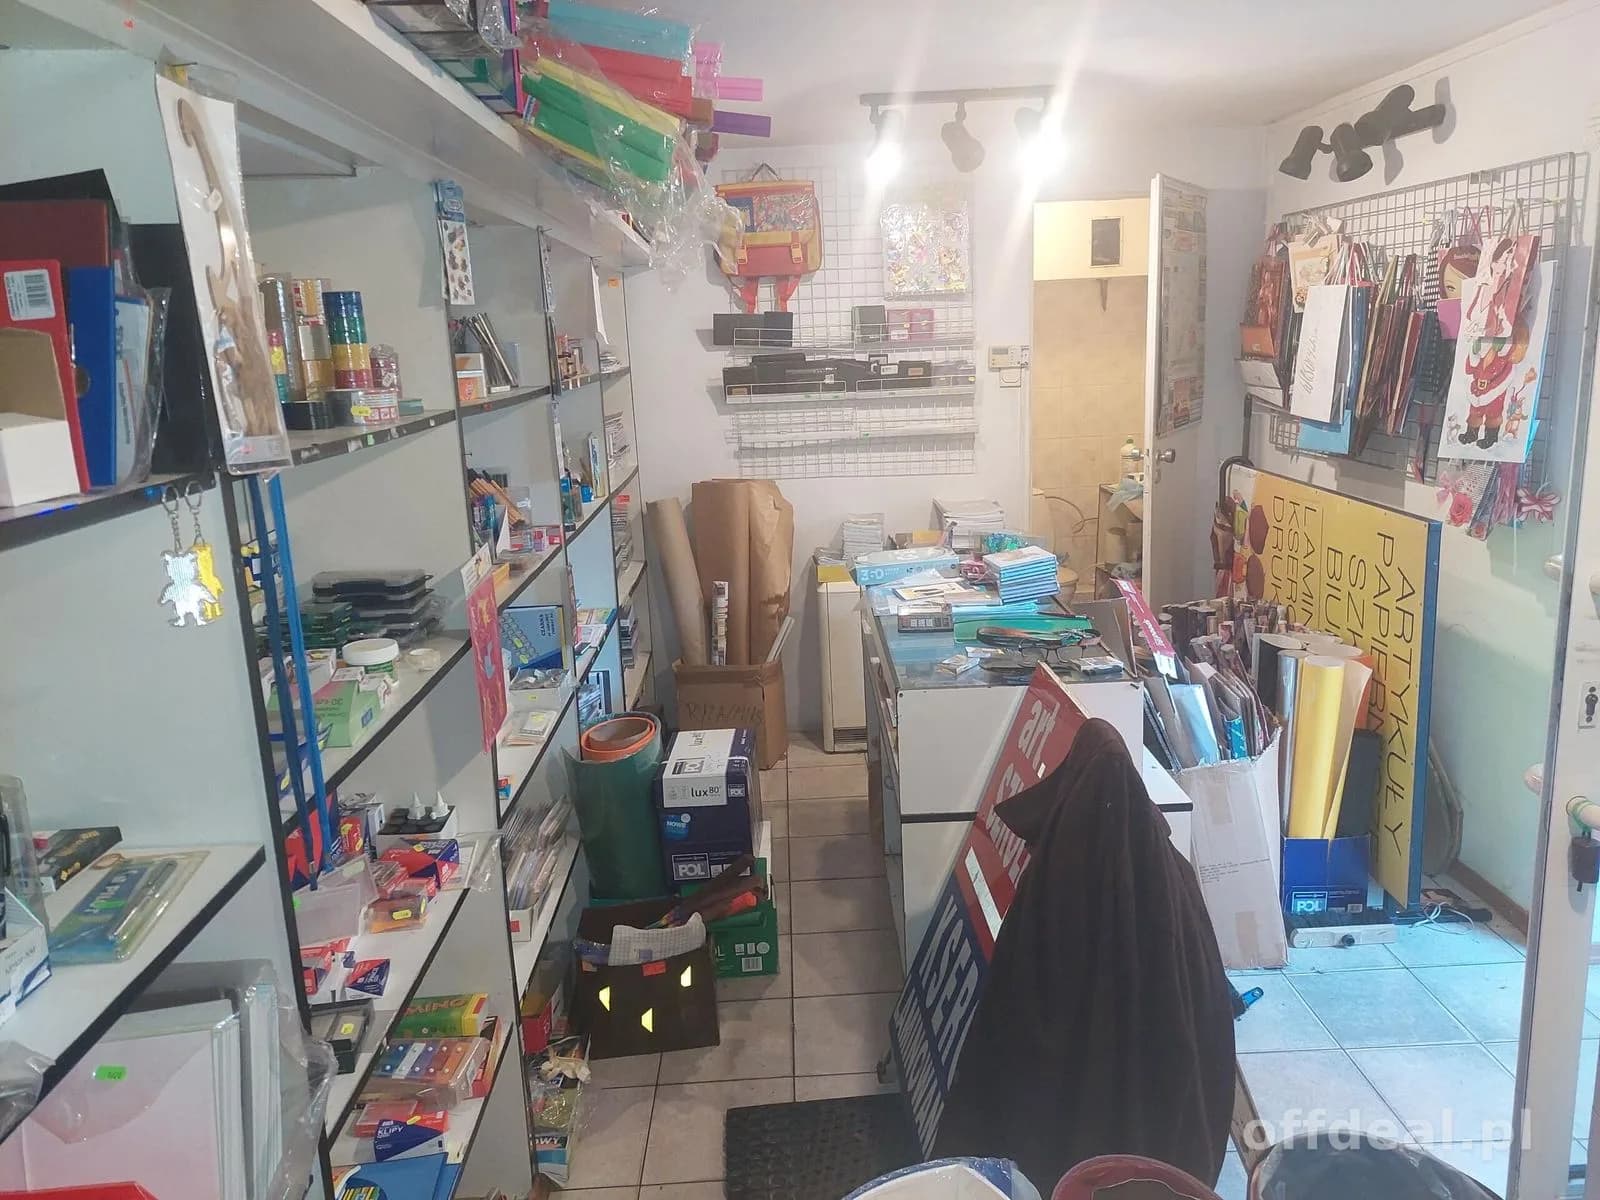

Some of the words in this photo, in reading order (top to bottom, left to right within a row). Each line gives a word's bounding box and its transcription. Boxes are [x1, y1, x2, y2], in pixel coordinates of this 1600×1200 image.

[1324, 546, 1344, 637] BIU
[1384, 566, 1416, 856] ARTYKUŁY
[679, 863, 706, 877] POL
[1297, 900, 1322, 912] POL
[918, 895, 981, 1092] KSER
[378, 1126, 404, 1137] KLIPY
